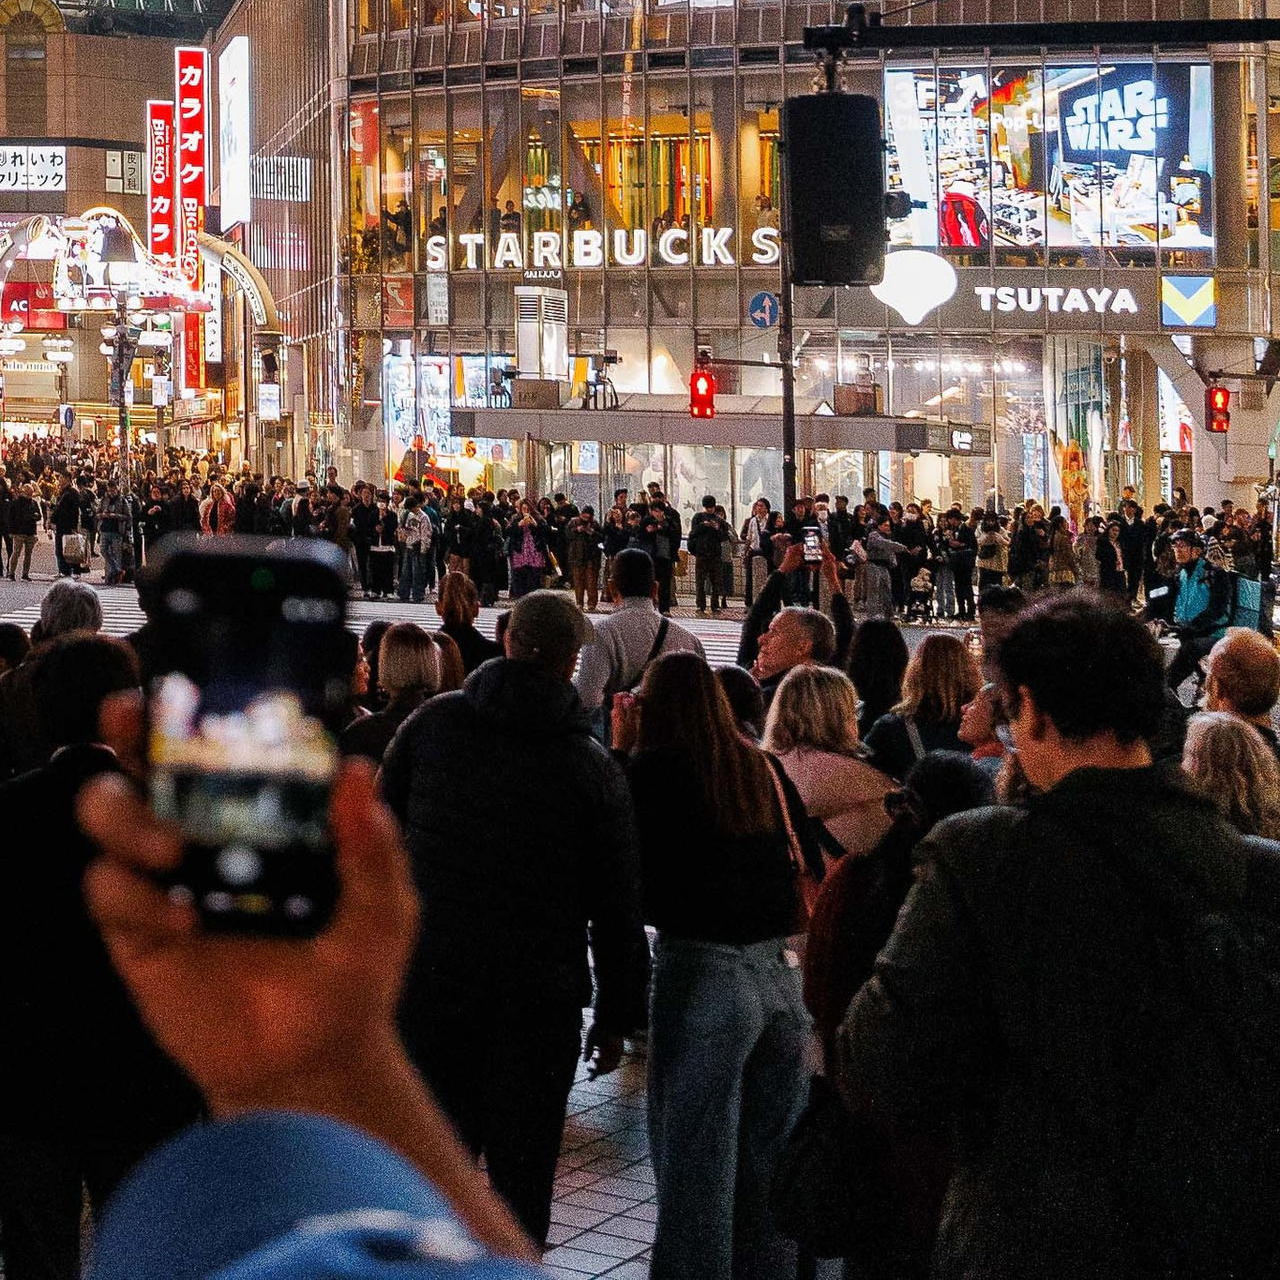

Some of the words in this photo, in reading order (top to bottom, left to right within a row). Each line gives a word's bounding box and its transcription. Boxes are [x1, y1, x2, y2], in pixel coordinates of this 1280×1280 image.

[152, 119, 166, 145] BIG
[179, 65, 204, 185] カラオケ
[10, 151, 64, 167] れいわ
[152, 146, 166, 185] ECHO
[182, 197, 198, 228] BIG
[426, 227, 780, 269] STARBUCKS
[974, 287, 1138, 314] TSUTAYA
